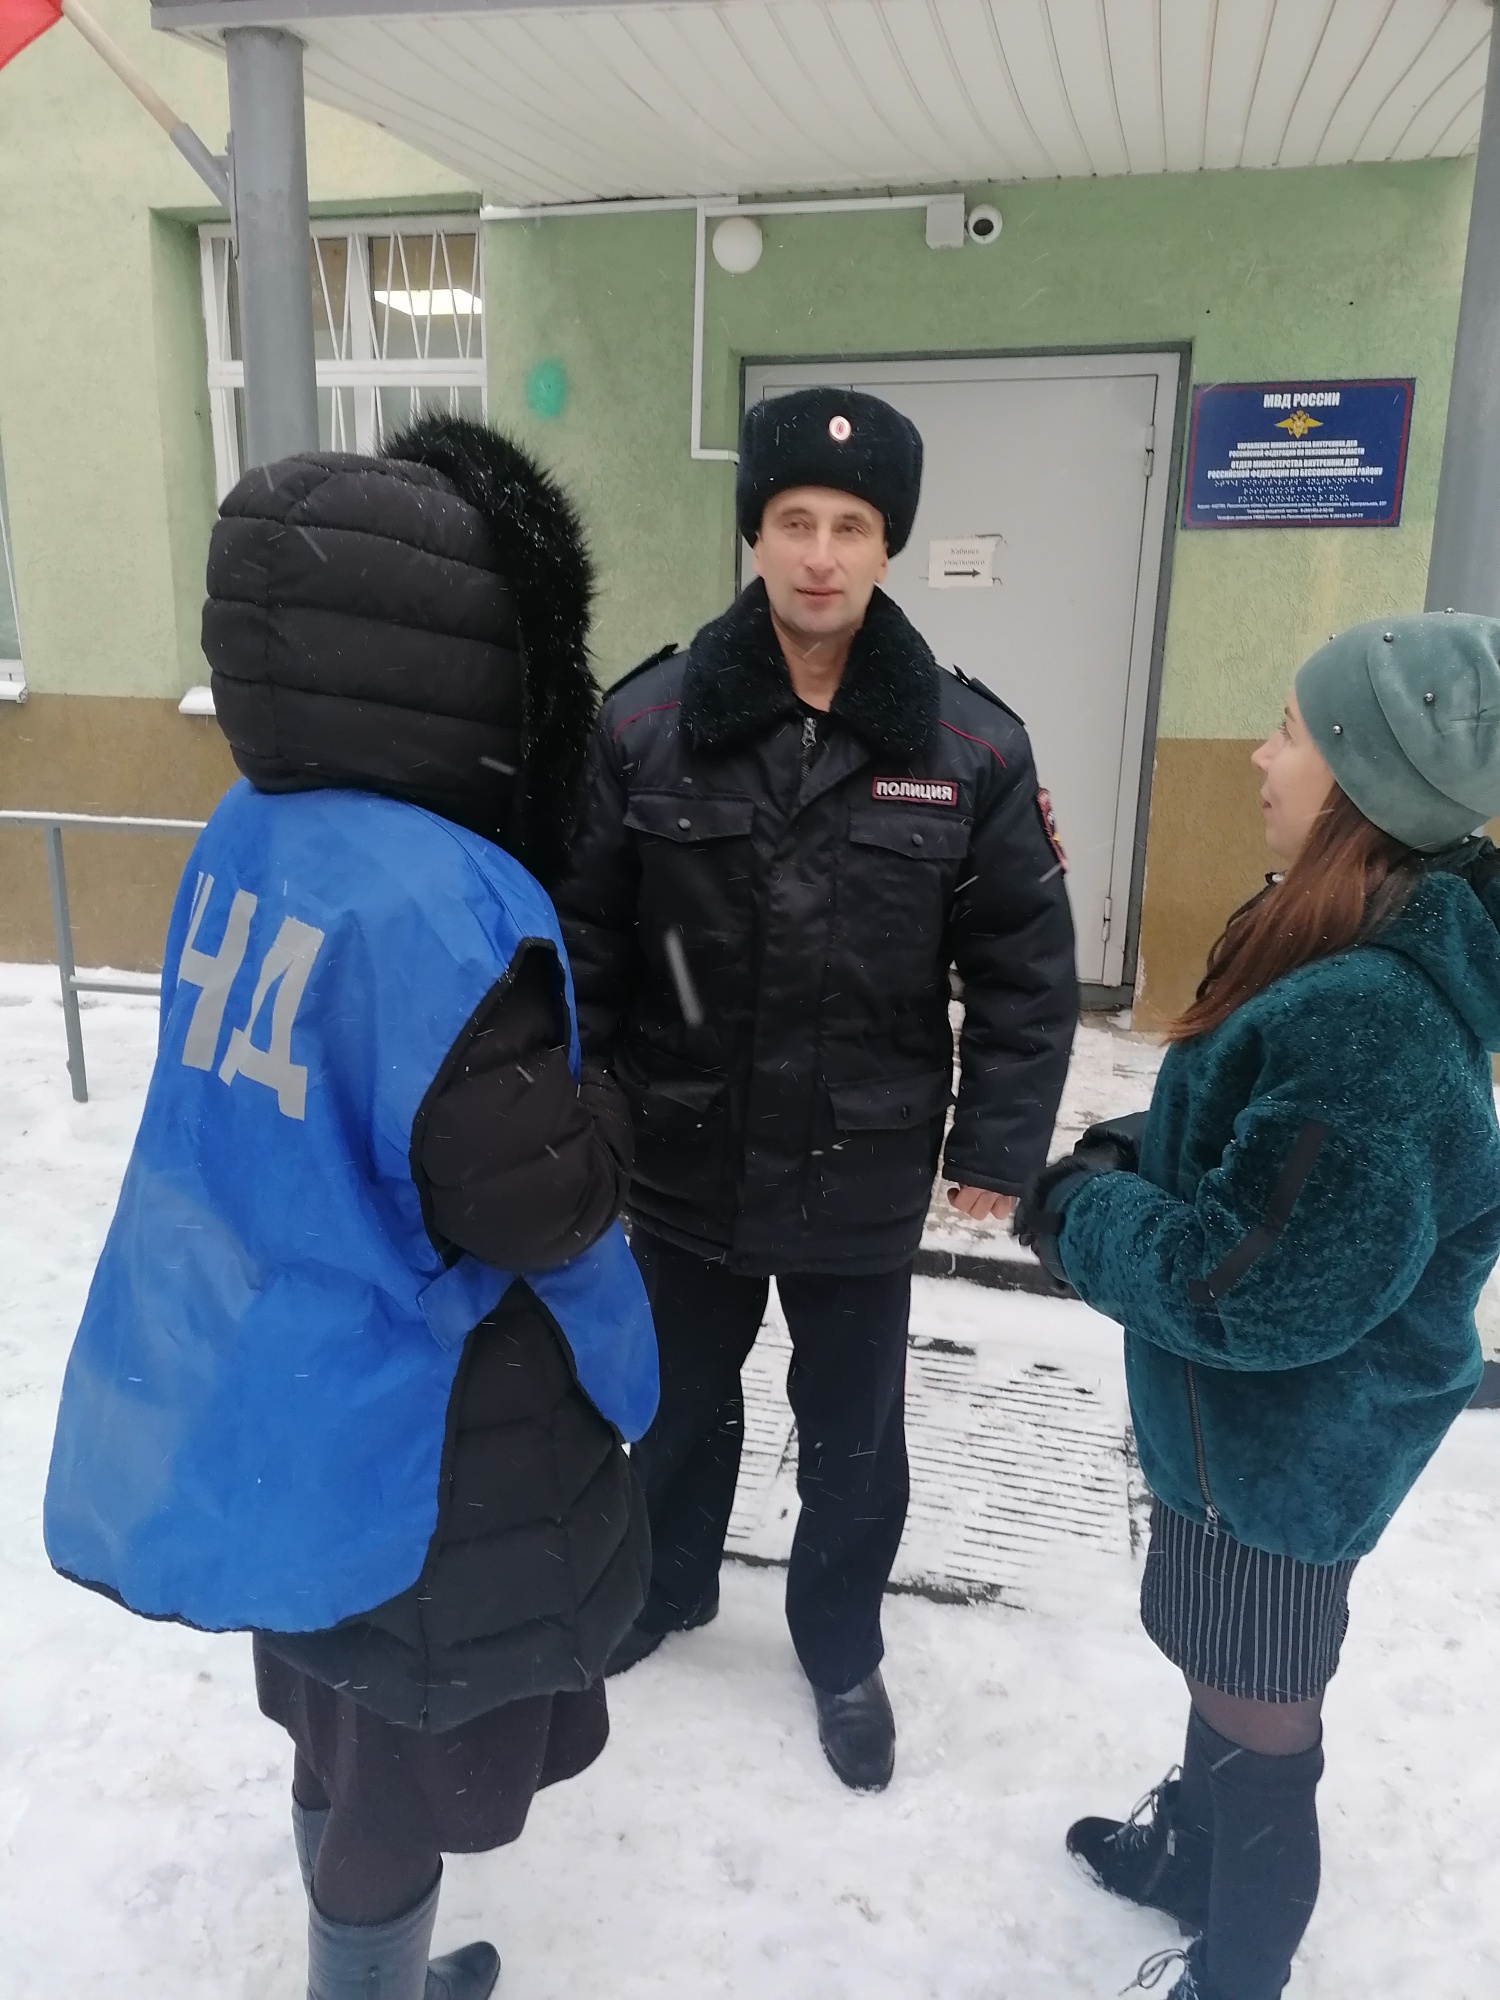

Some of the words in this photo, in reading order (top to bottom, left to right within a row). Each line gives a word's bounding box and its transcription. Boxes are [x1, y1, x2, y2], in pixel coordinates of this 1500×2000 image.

[1263, 393, 1291, 409] МВД
[1293, 392, 1340, 407] РОССИИ
[1345, 439, 1358, 448] ДЕЛ
[1231, 460, 1252, 469] ОТДЕЛ
[1252, 459, 1303, 469] МИНИСТЕРСТВА
[1303, 458, 1344, 467] ВНУТРЕННИХ
[1344, 458, 1359, 467] ДЕЛ
[1207, 469, 1250, 479] РОССИЙСКОЙ
[1250, 469, 1289, 479] ФЕДЕРАЦИИ
[1289, 468, 1299, 477] ПО
[1357, 466, 1383, 476] РАЙОНУ
[876, 781, 953, 801] ПОЛИЦИЯ
